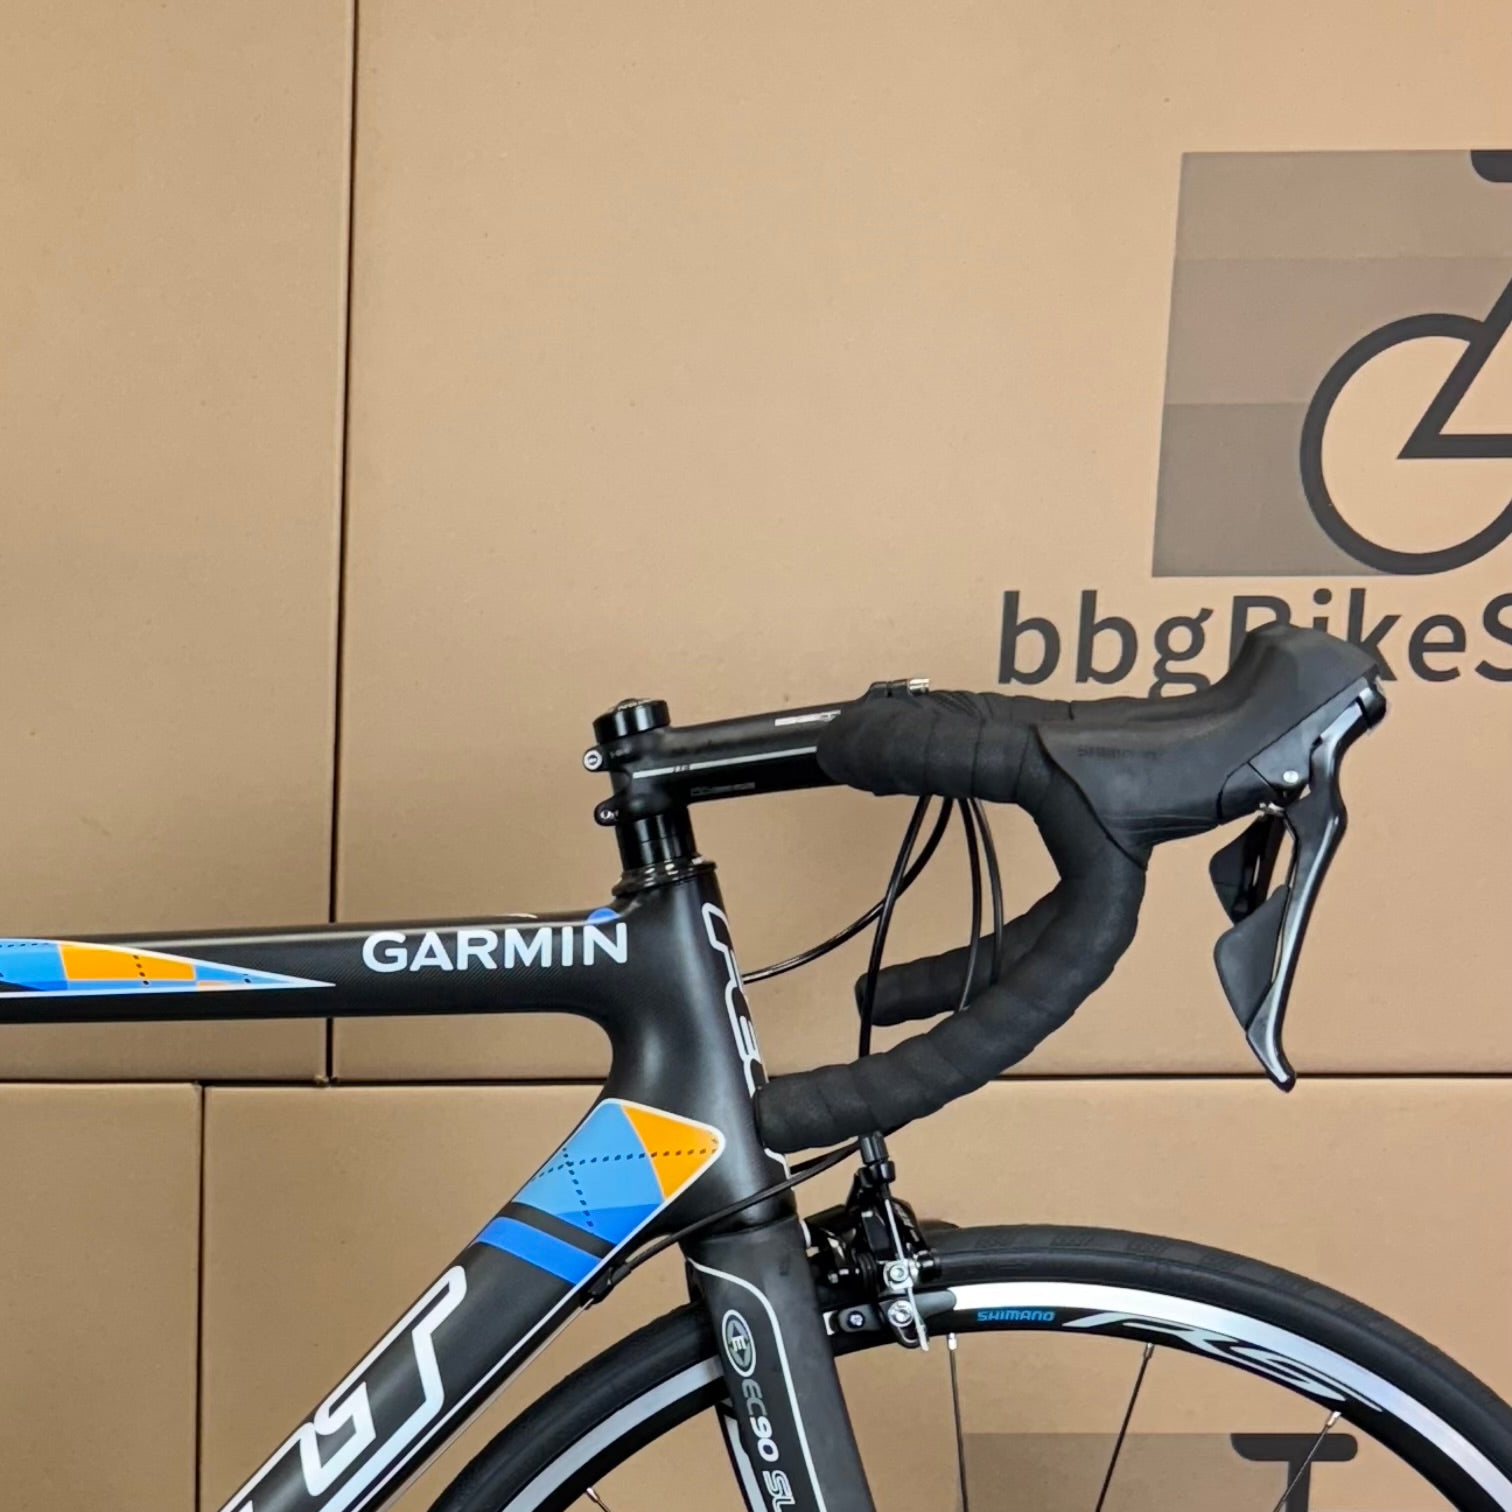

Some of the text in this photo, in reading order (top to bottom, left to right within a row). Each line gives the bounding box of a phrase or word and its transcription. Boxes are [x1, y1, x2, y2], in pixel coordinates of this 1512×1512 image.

[362, 922, 627, 973] GARMIN
[976, 1310, 1055, 1322] SHIMANO
[742, 1378, 796, 1506] EC90 SL
